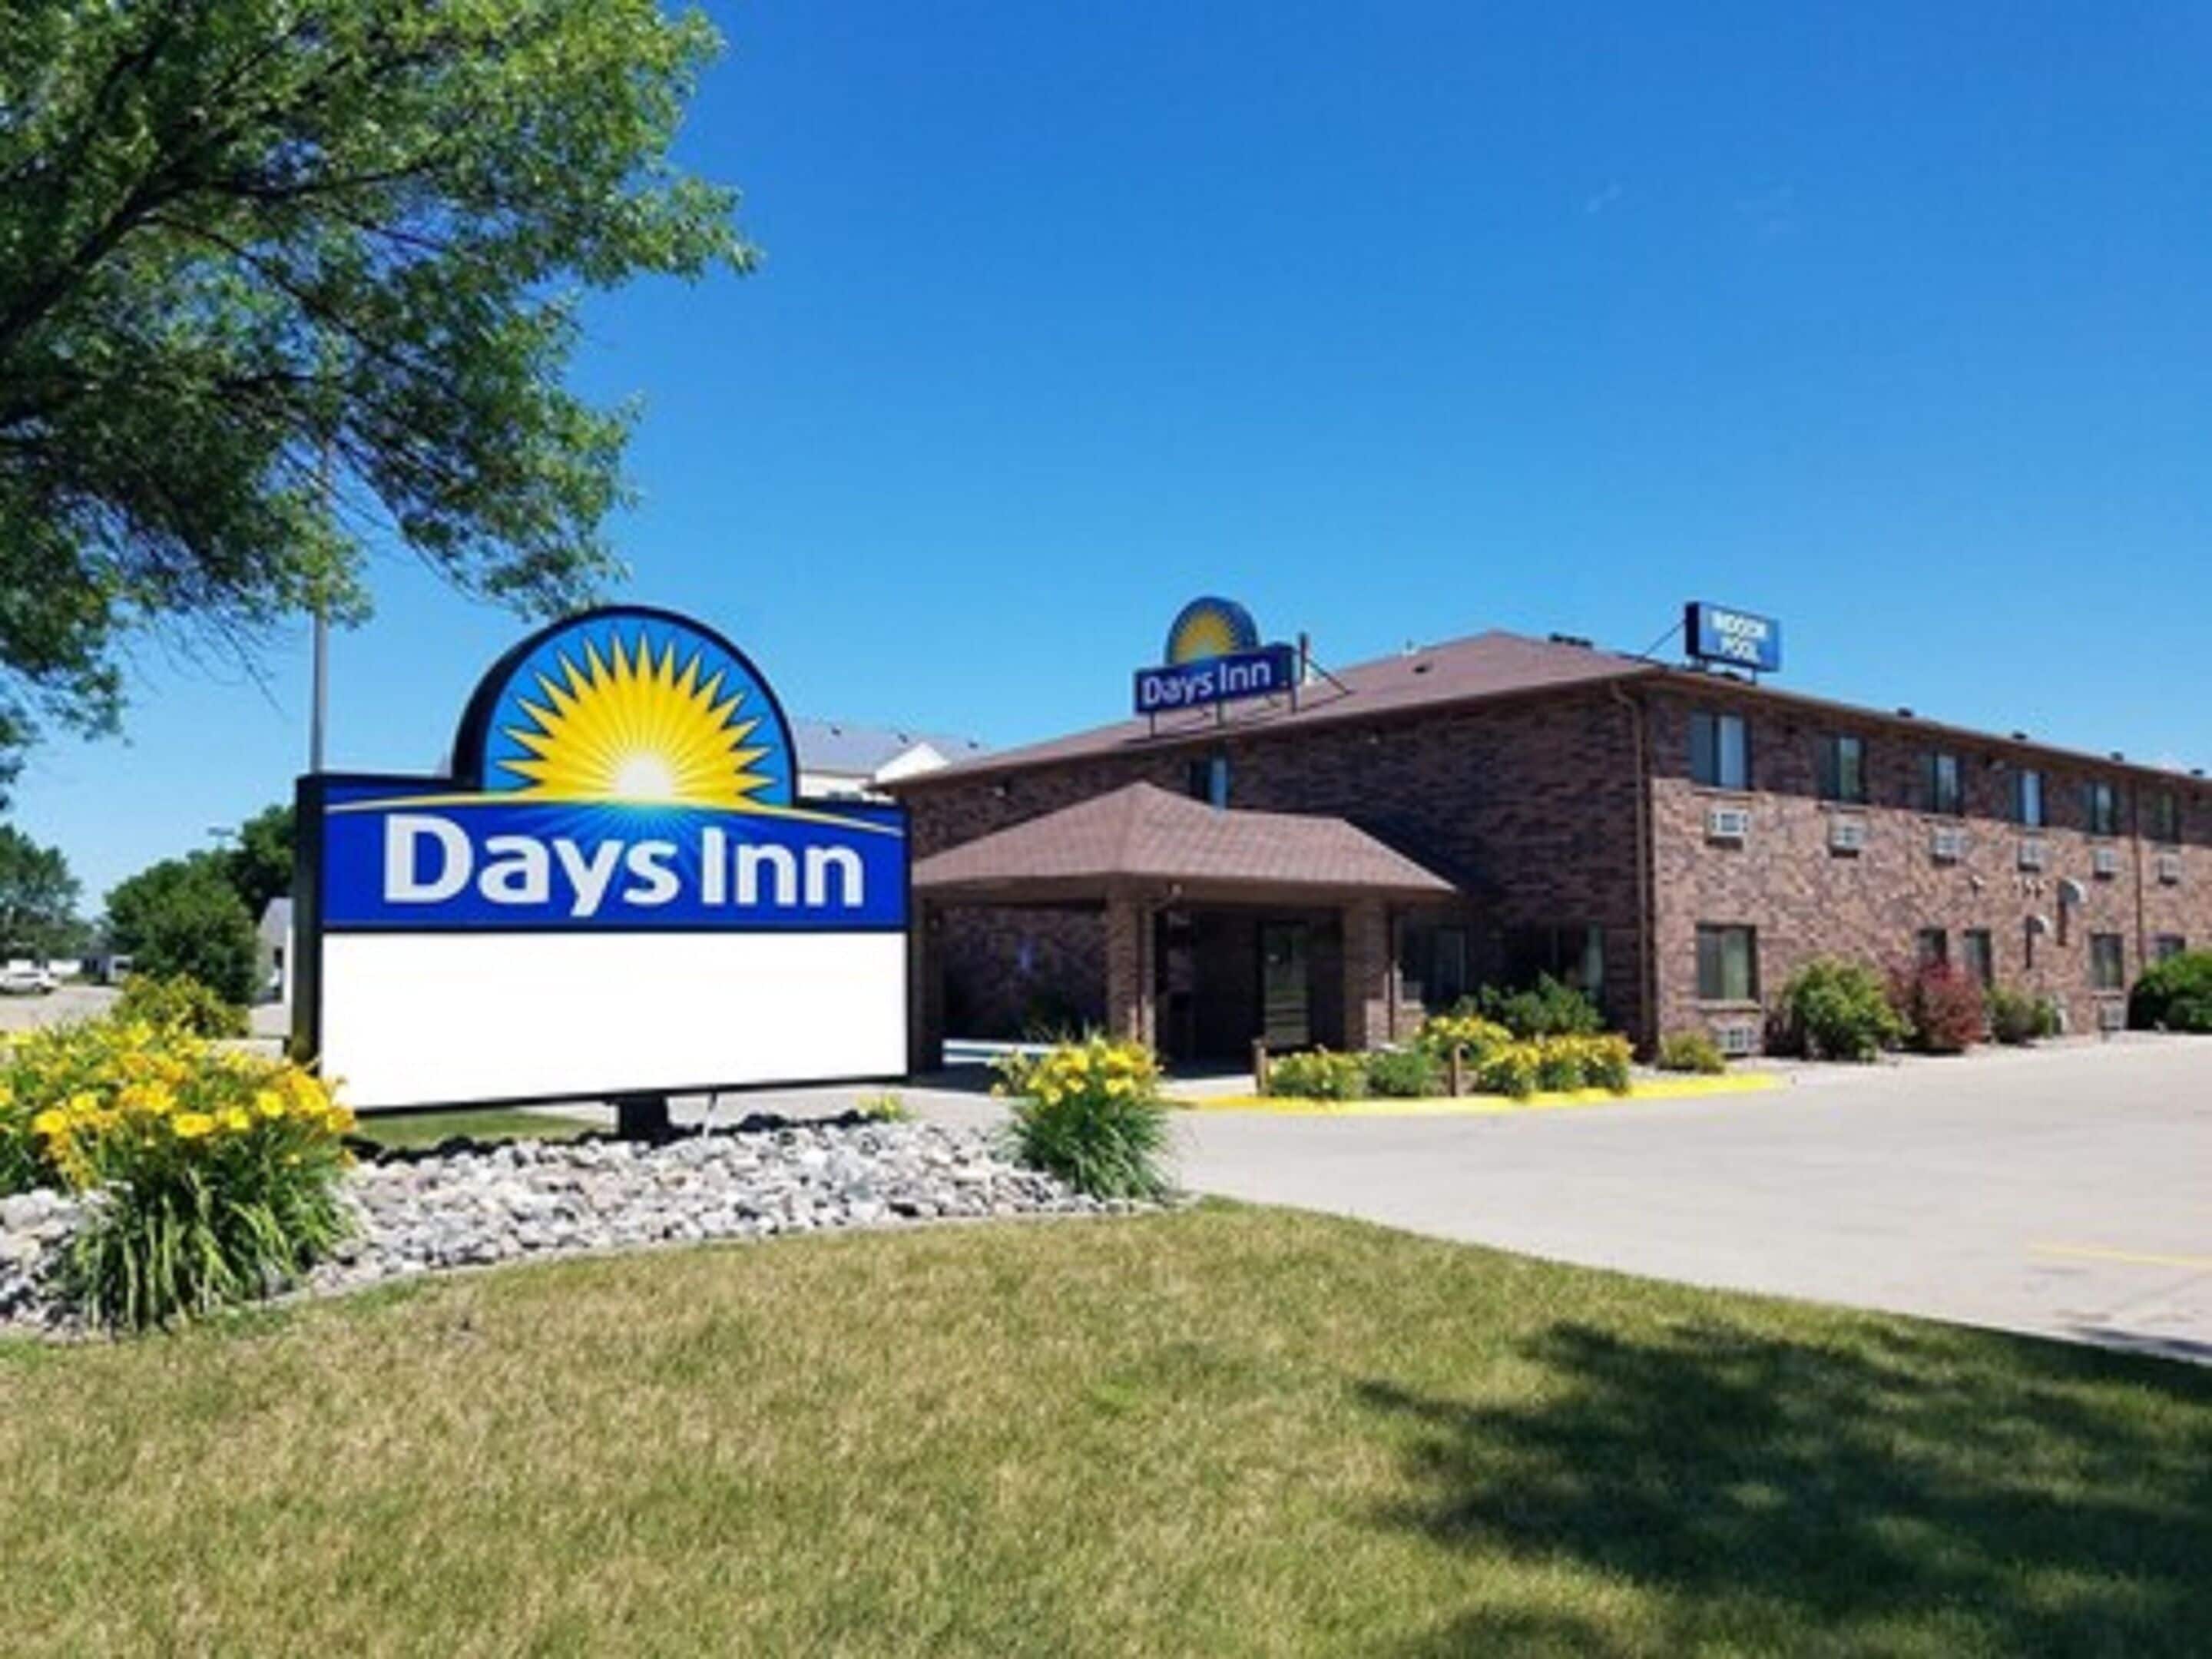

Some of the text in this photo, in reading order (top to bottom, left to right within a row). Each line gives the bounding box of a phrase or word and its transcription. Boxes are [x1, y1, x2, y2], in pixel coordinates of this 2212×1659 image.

[1142, 662, 1271, 705] Days Inn
[384, 813, 863, 917] Days Inn
